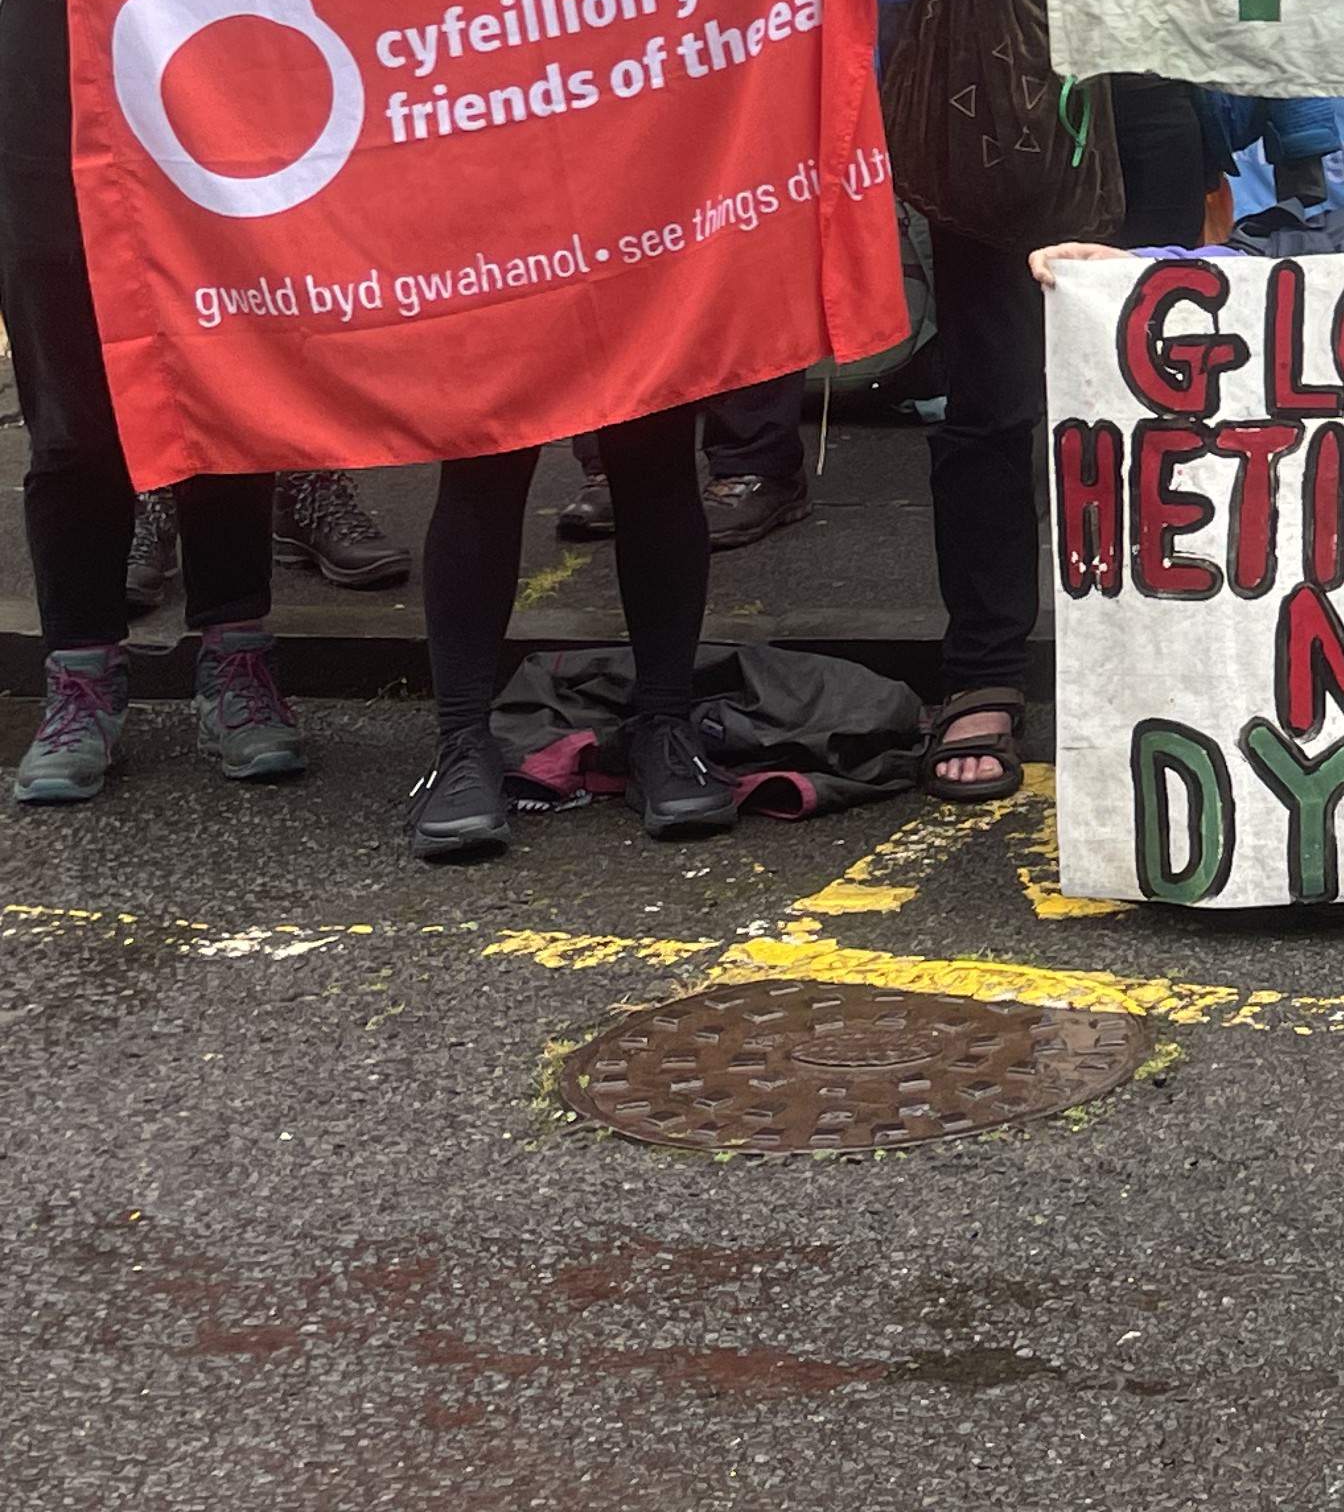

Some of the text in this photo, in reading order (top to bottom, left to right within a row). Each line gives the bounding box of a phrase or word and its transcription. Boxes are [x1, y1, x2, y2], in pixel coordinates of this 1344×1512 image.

[385, 63, 599, 143] friends
[610, 37, 667, 99] of
[194, 277, 298, 328] gweld
[306, 271, 381, 322] byd
[395, 236, 591, 318] gwahanol
[619, 222, 686, 263] see
[691, 182, 779, 242] things
